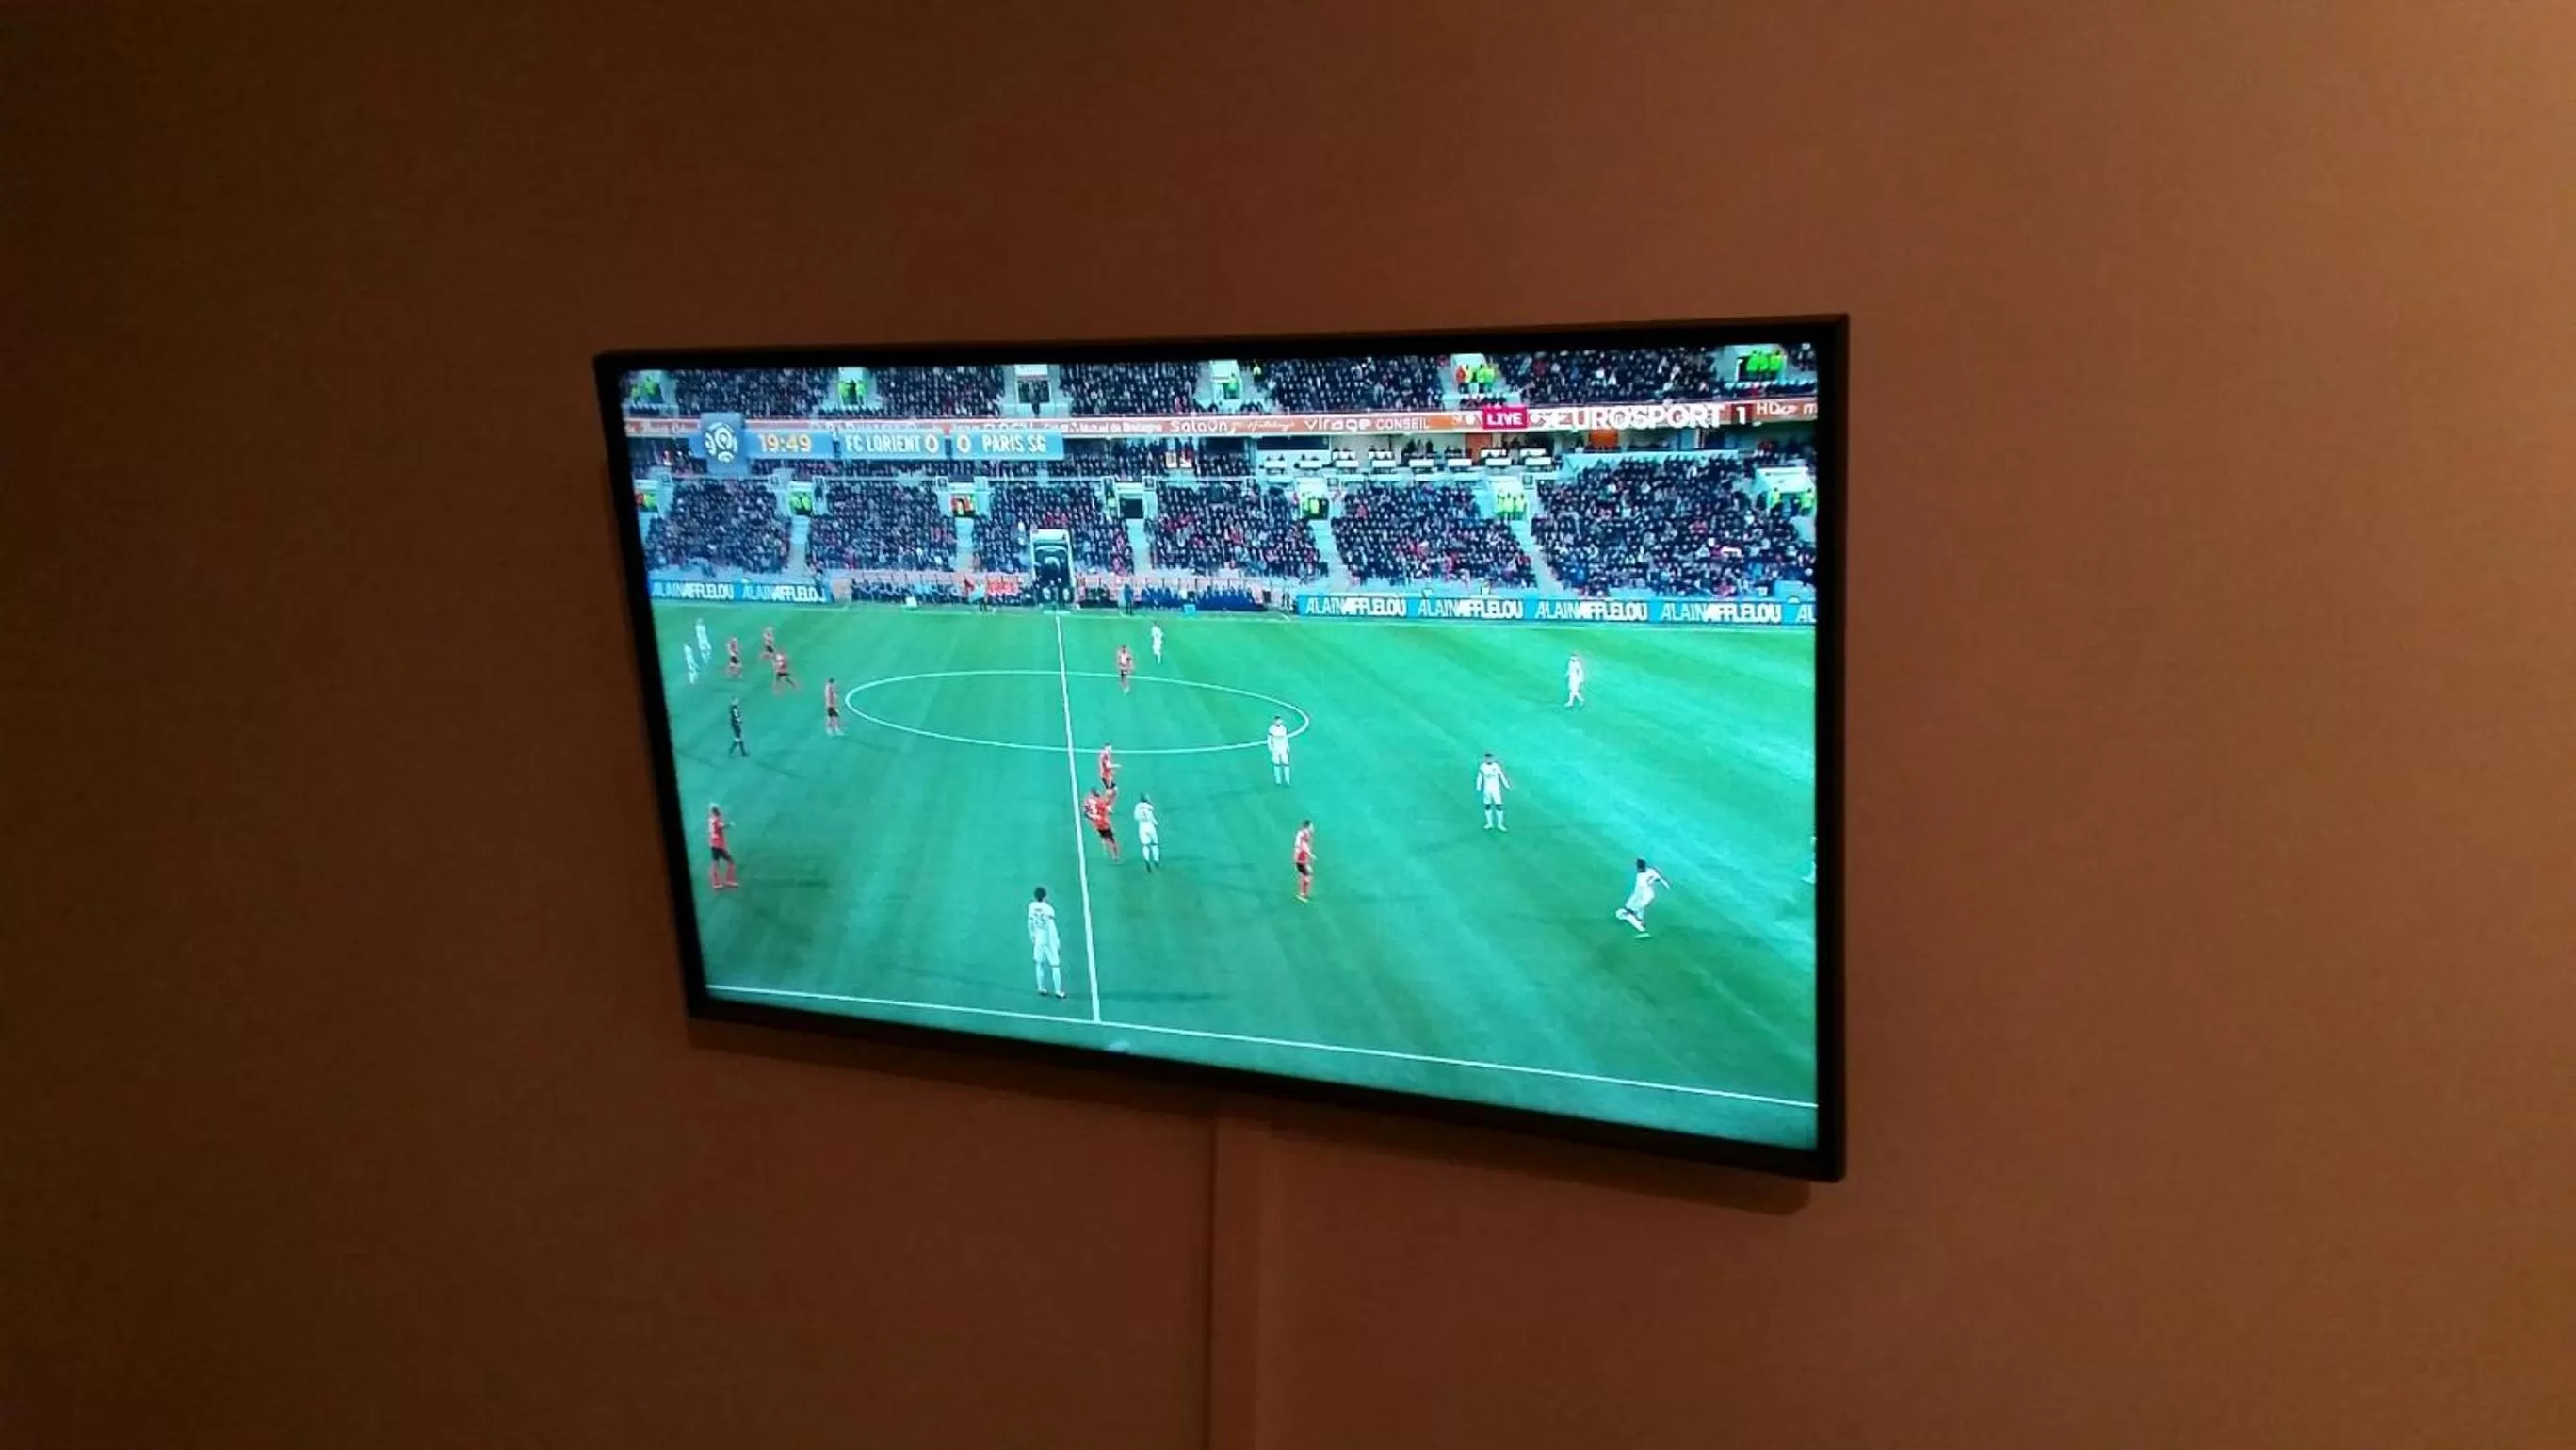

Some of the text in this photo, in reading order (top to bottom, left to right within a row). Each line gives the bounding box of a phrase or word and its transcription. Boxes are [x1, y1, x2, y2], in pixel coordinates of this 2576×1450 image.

[1375, 416, 1430, 430] CONSEIL
[1487, 412, 1523, 426] LIVE
[1553, 403, 1746, 431] EUROSPORT 1
[759, 433, 812, 453] 19:49
[846, 434, 940, 453] FC LORIENT 0
[956, 434, 1048, 453] 0 PARIS SG
